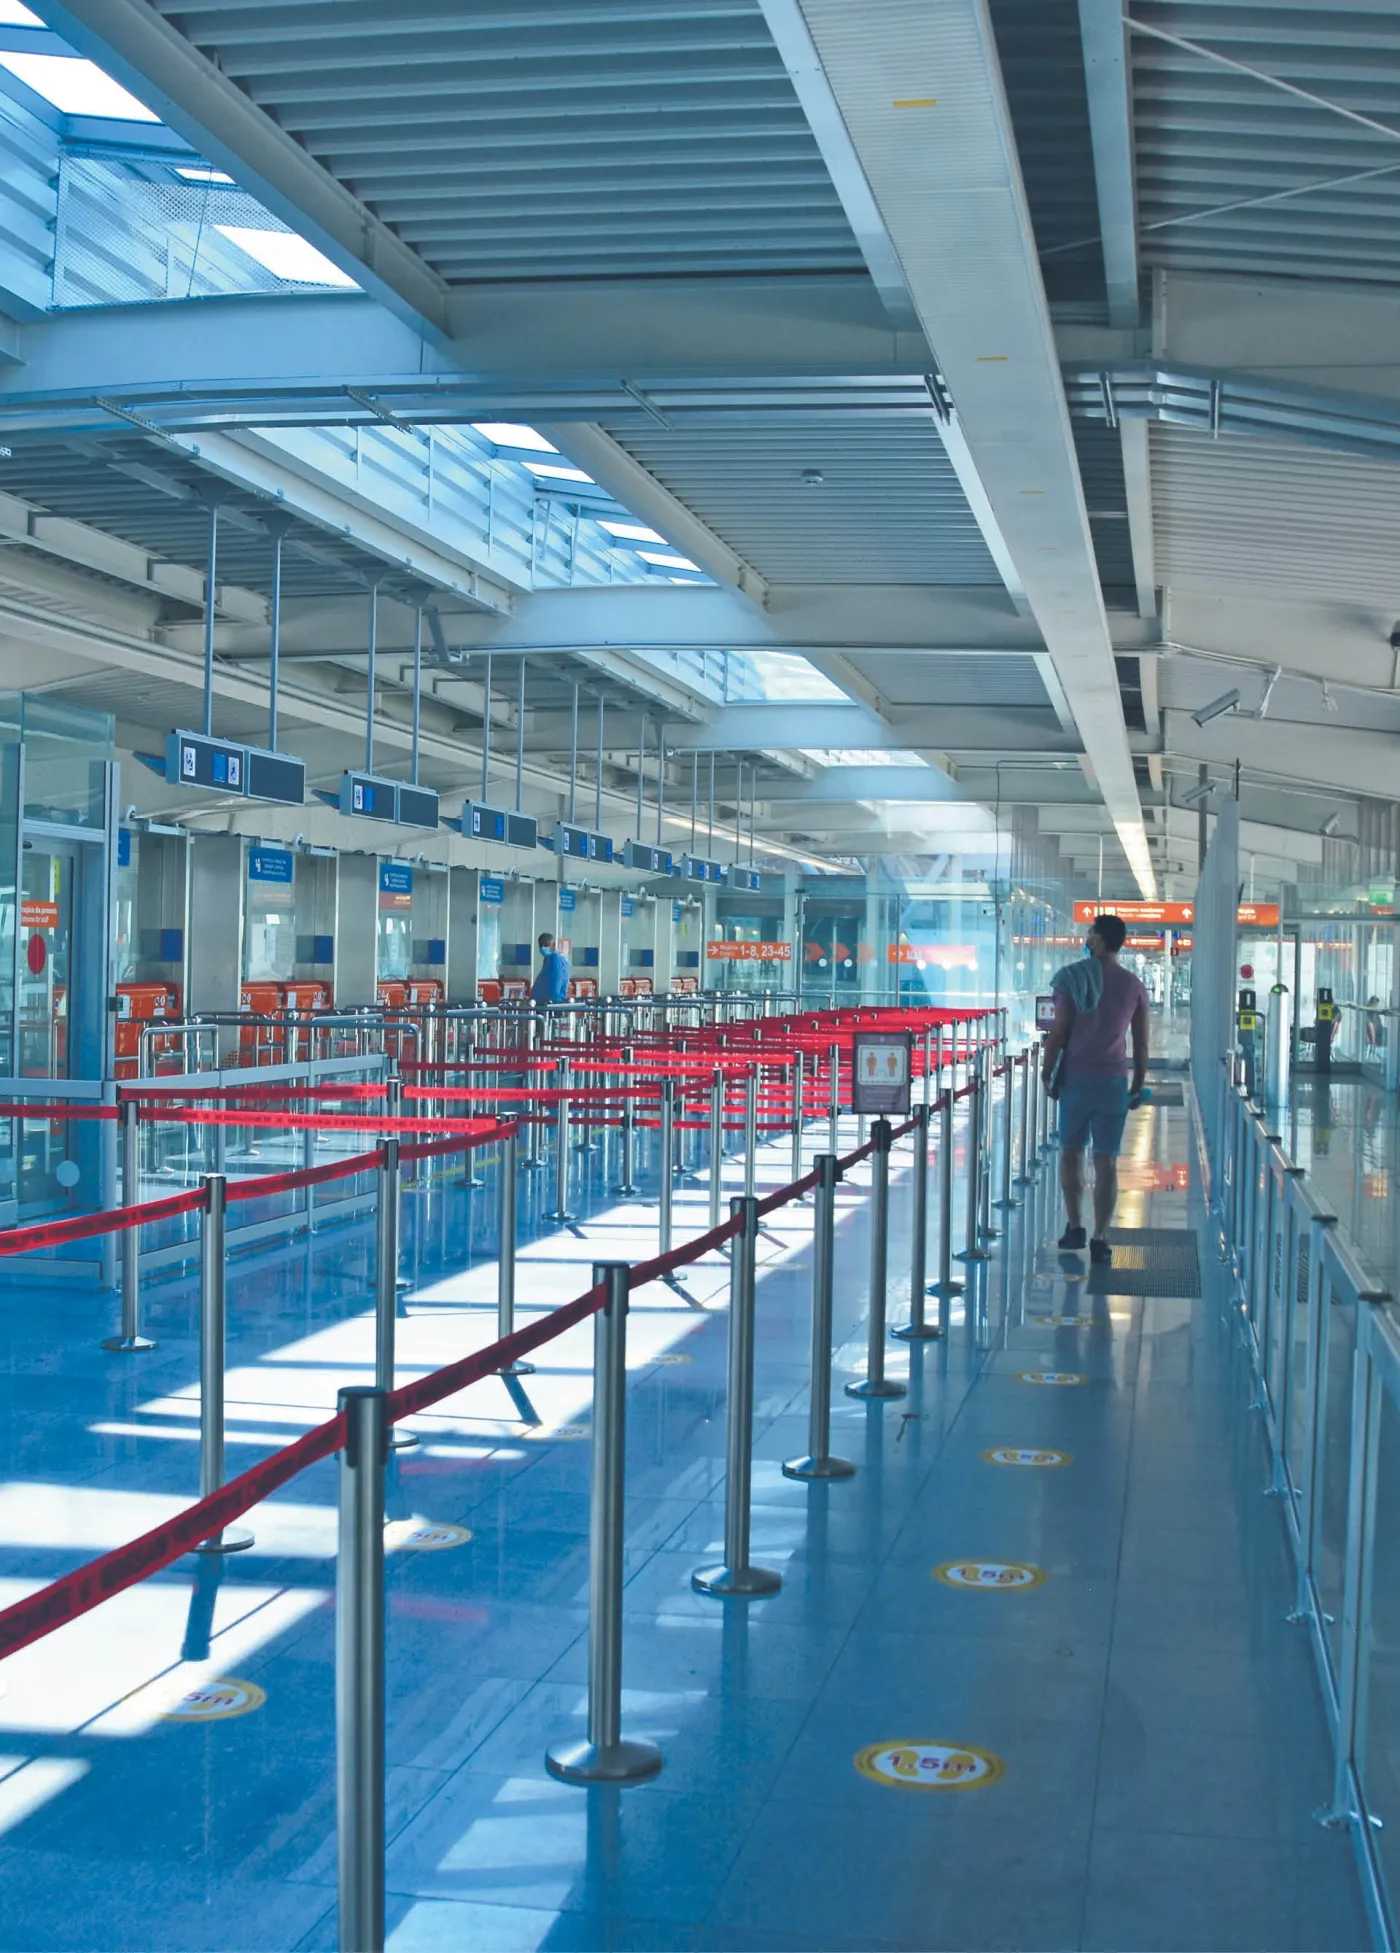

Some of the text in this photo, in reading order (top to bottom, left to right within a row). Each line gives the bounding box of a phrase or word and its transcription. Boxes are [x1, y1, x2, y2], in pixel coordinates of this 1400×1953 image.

[740, 944, 759, 958] 1-8,
[761, 944, 791, 957] 23-45
[958, 1568, 1024, 1580] 15m
